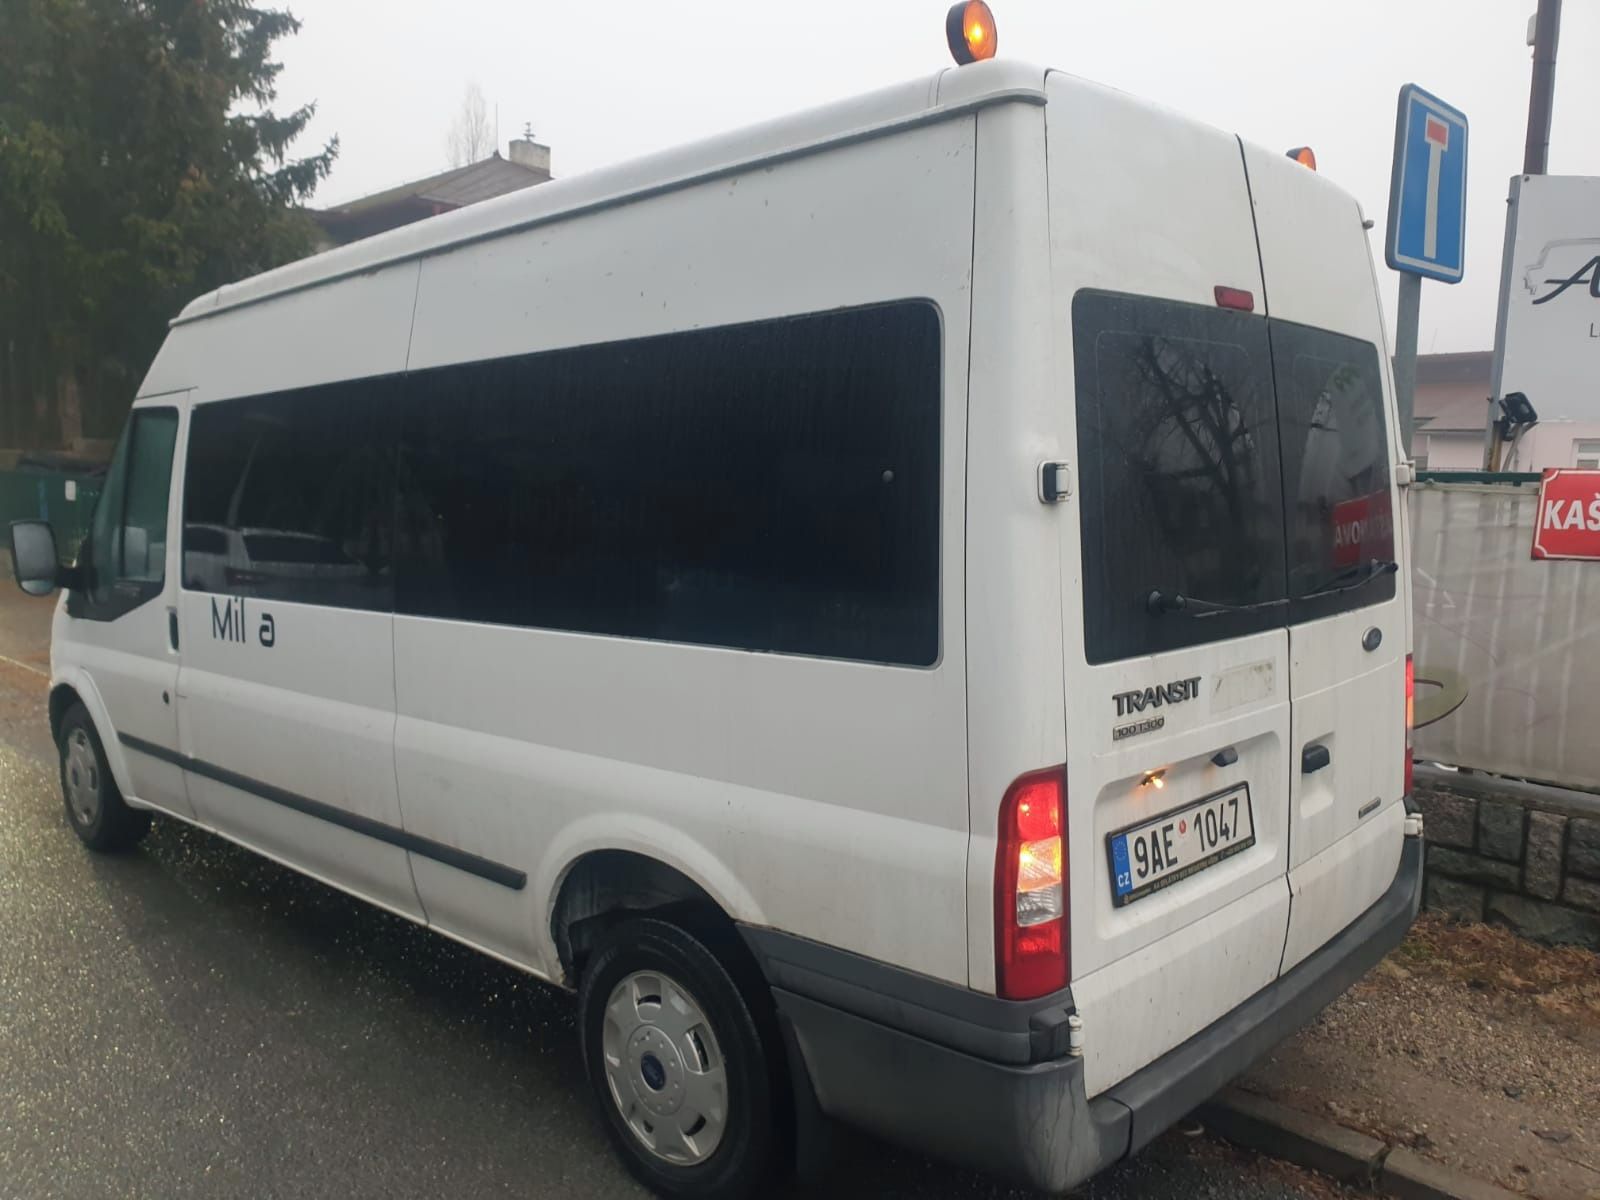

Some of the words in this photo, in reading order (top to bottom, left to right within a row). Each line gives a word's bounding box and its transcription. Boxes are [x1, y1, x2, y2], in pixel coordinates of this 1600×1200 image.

[1589, 322, 1600, 338] L
[1543, 492, 1600, 532] KAŠ
[211, 596, 246, 644] Mil
[259, 612, 275, 648] a
[1112, 676, 1202, 717] TRANSIT
[1133, 824, 1178, 879] 9AE
[1193, 797, 1240, 852] 1047
[1117, 872, 1130, 888] CZ
